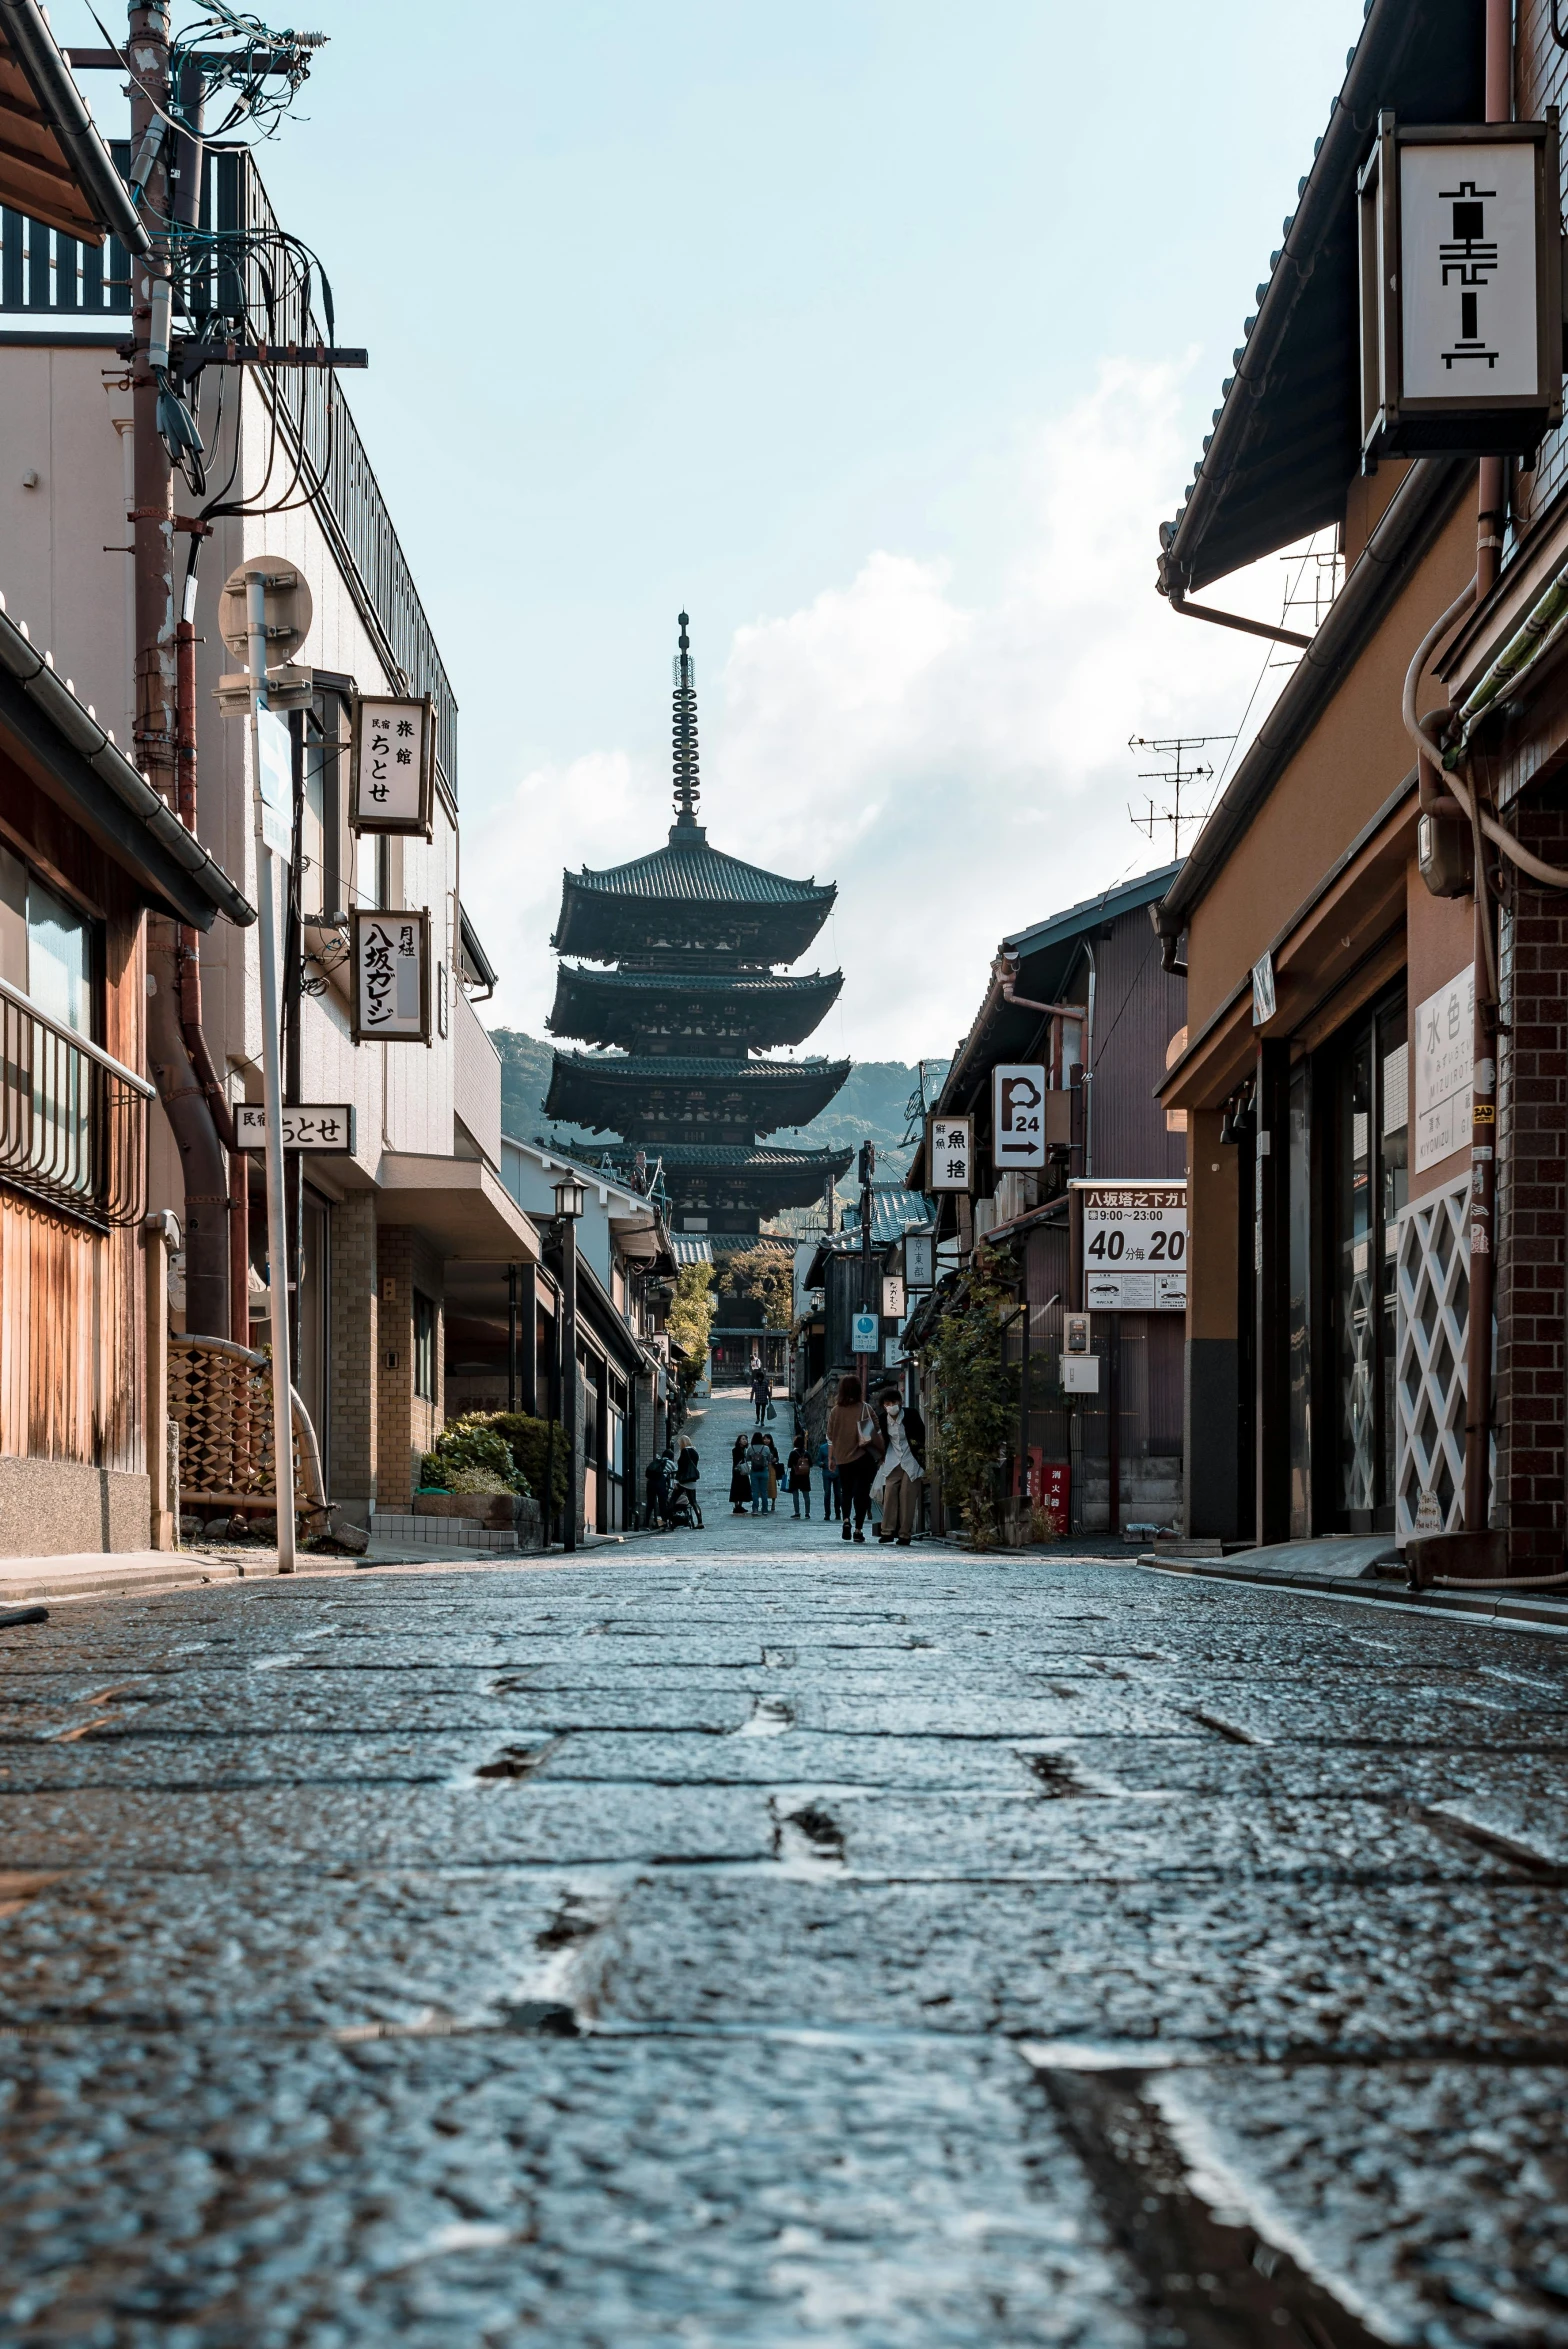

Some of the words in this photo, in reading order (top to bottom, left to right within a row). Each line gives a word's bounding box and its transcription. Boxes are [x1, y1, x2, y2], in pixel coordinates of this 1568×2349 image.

[371, 718, 390, 730] 民宿
[396, 718, 415, 766] 旅館
[368, 733, 390, 804] ちとせ
[397, 925, 416, 957] 月極
[364, 922, 396, 1026] 八坂ガレージ
[935, 1124, 946, 1150] 鮮魚
[1015, 1116, 1039, 1132] 24
[1461, 1114, 1474, 1135] GI
[1420, 1130, 1449, 1159] KIYOMIZU
[1050, 1470, 1062, 1507] 消火器
